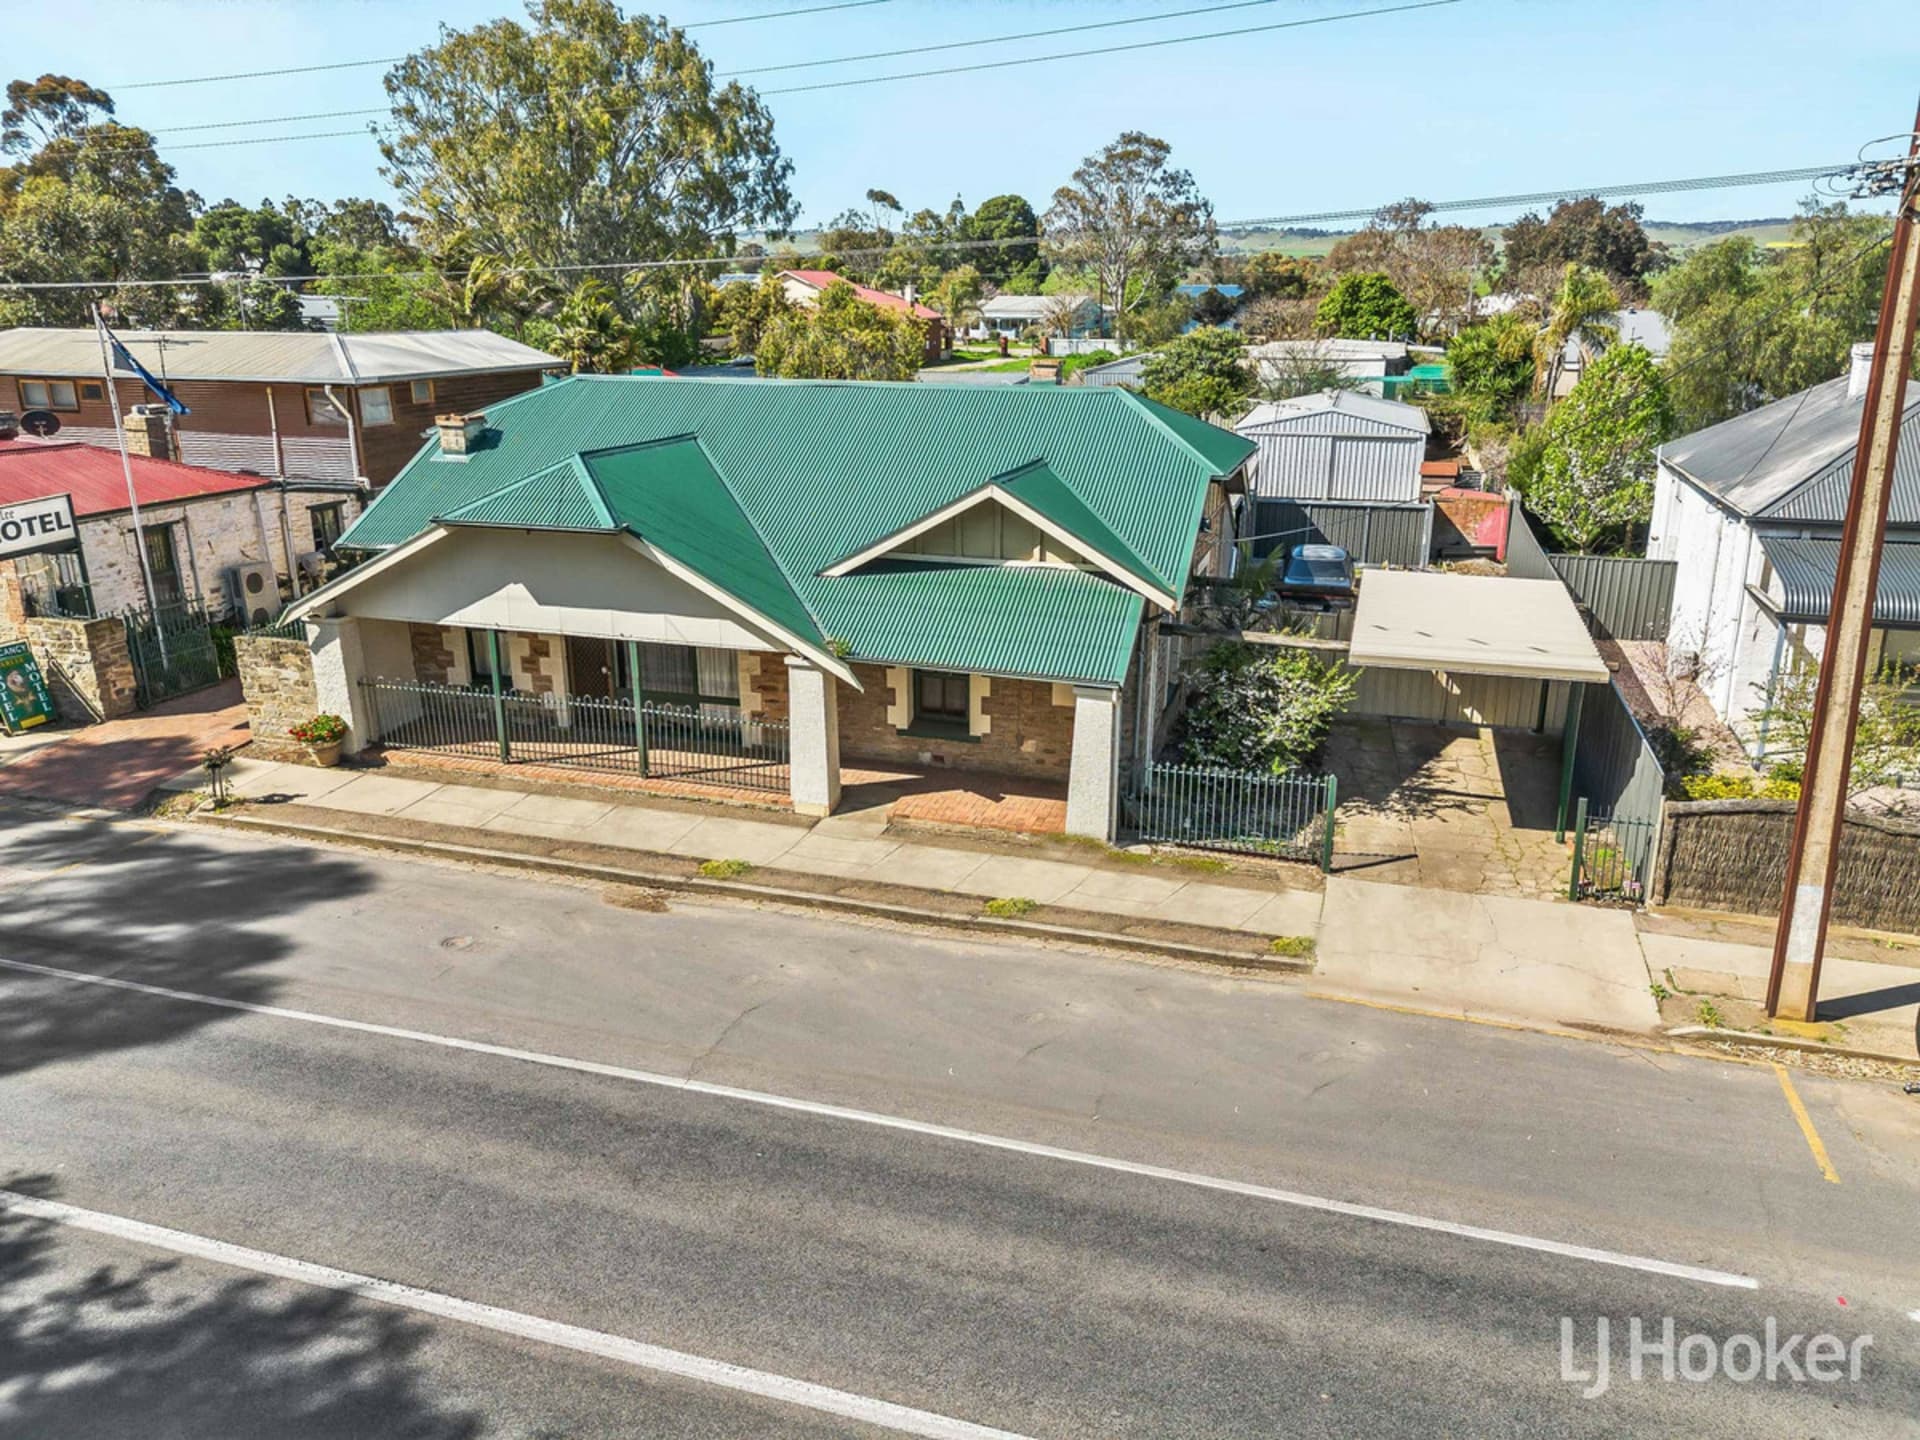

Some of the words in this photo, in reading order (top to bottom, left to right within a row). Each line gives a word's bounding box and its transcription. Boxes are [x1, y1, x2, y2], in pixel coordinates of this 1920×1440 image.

[0, 511, 71, 543] OTEL
[0, 675, 18, 722] OTEL
[24, 661, 52, 712] MOTEL
